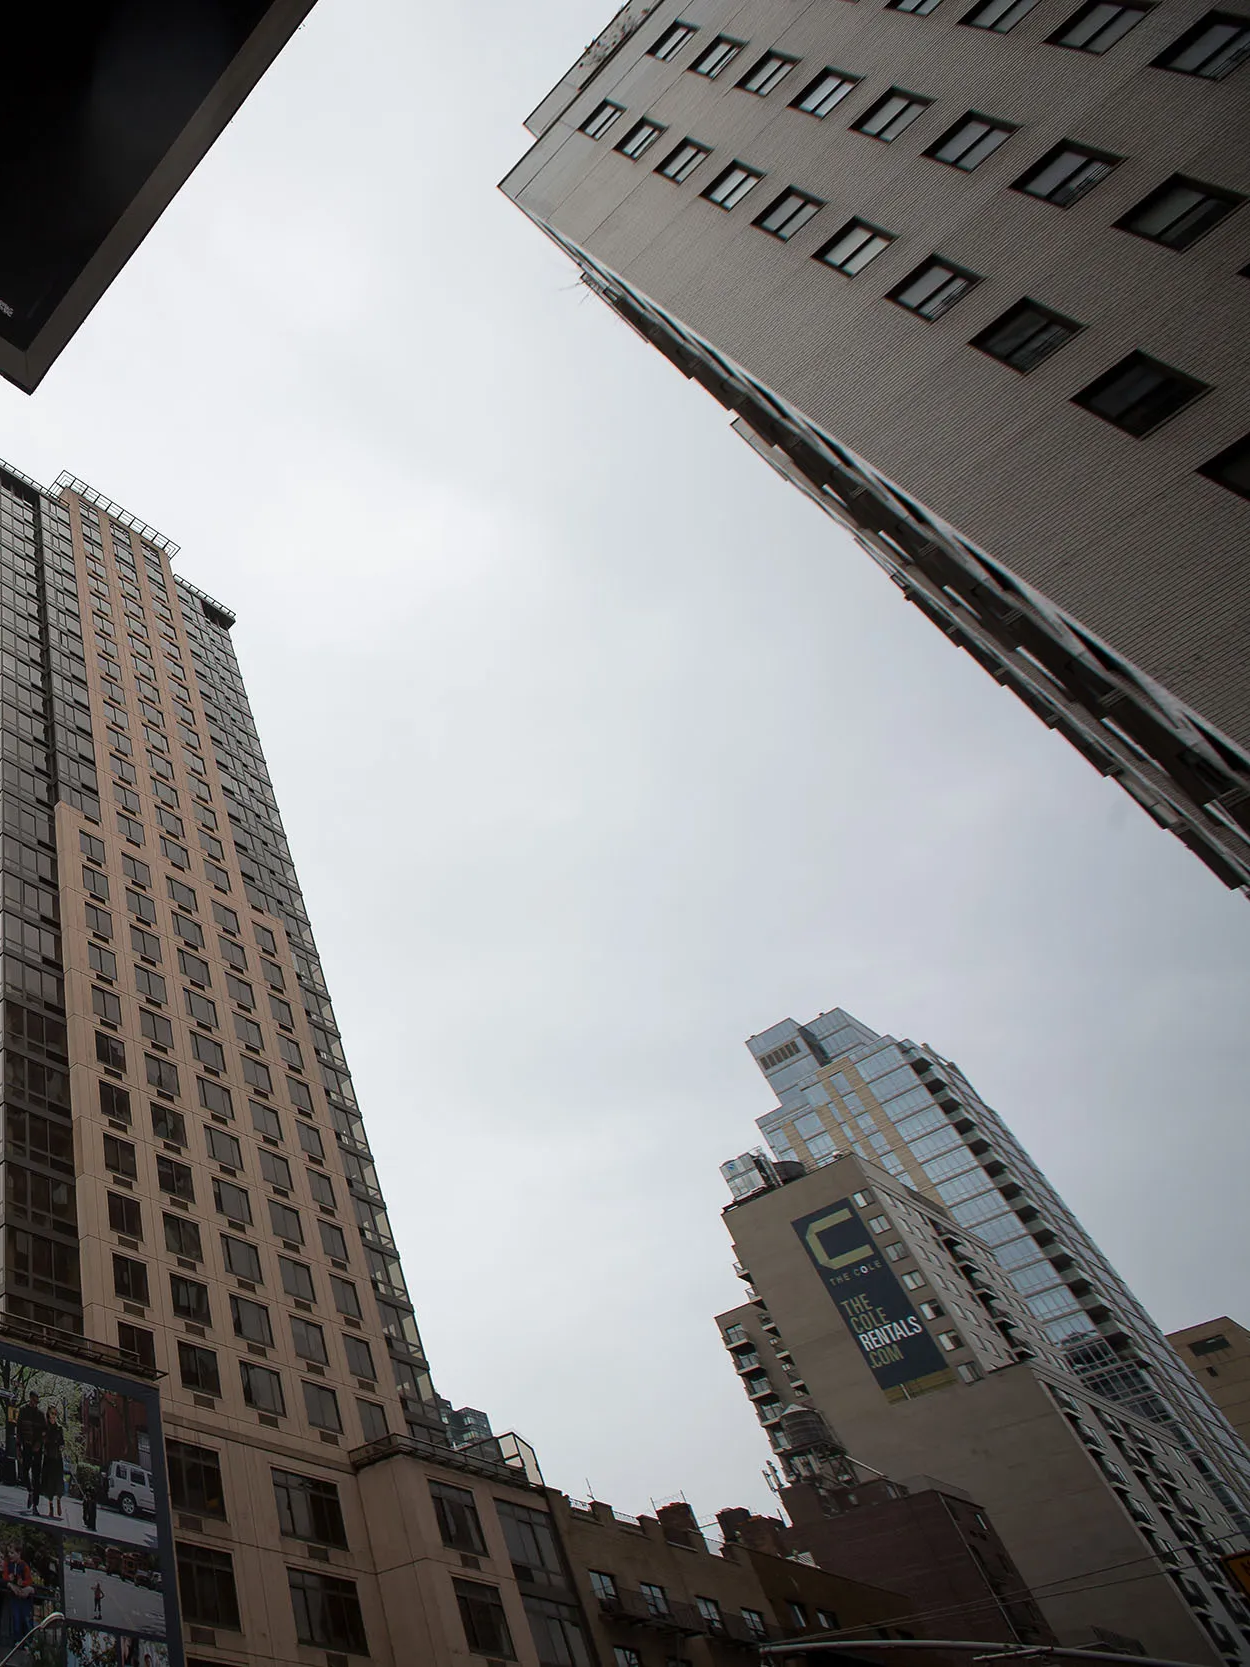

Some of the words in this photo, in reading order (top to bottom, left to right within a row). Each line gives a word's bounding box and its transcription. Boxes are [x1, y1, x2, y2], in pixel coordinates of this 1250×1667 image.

[830, 1271, 851, 1287] THE
[854, 1259, 883, 1278] COLE
[840, 1293, 874, 1318] THE
[850, 1306, 892, 1335] COLE
[857, 1315, 923, 1352] RENTALS
